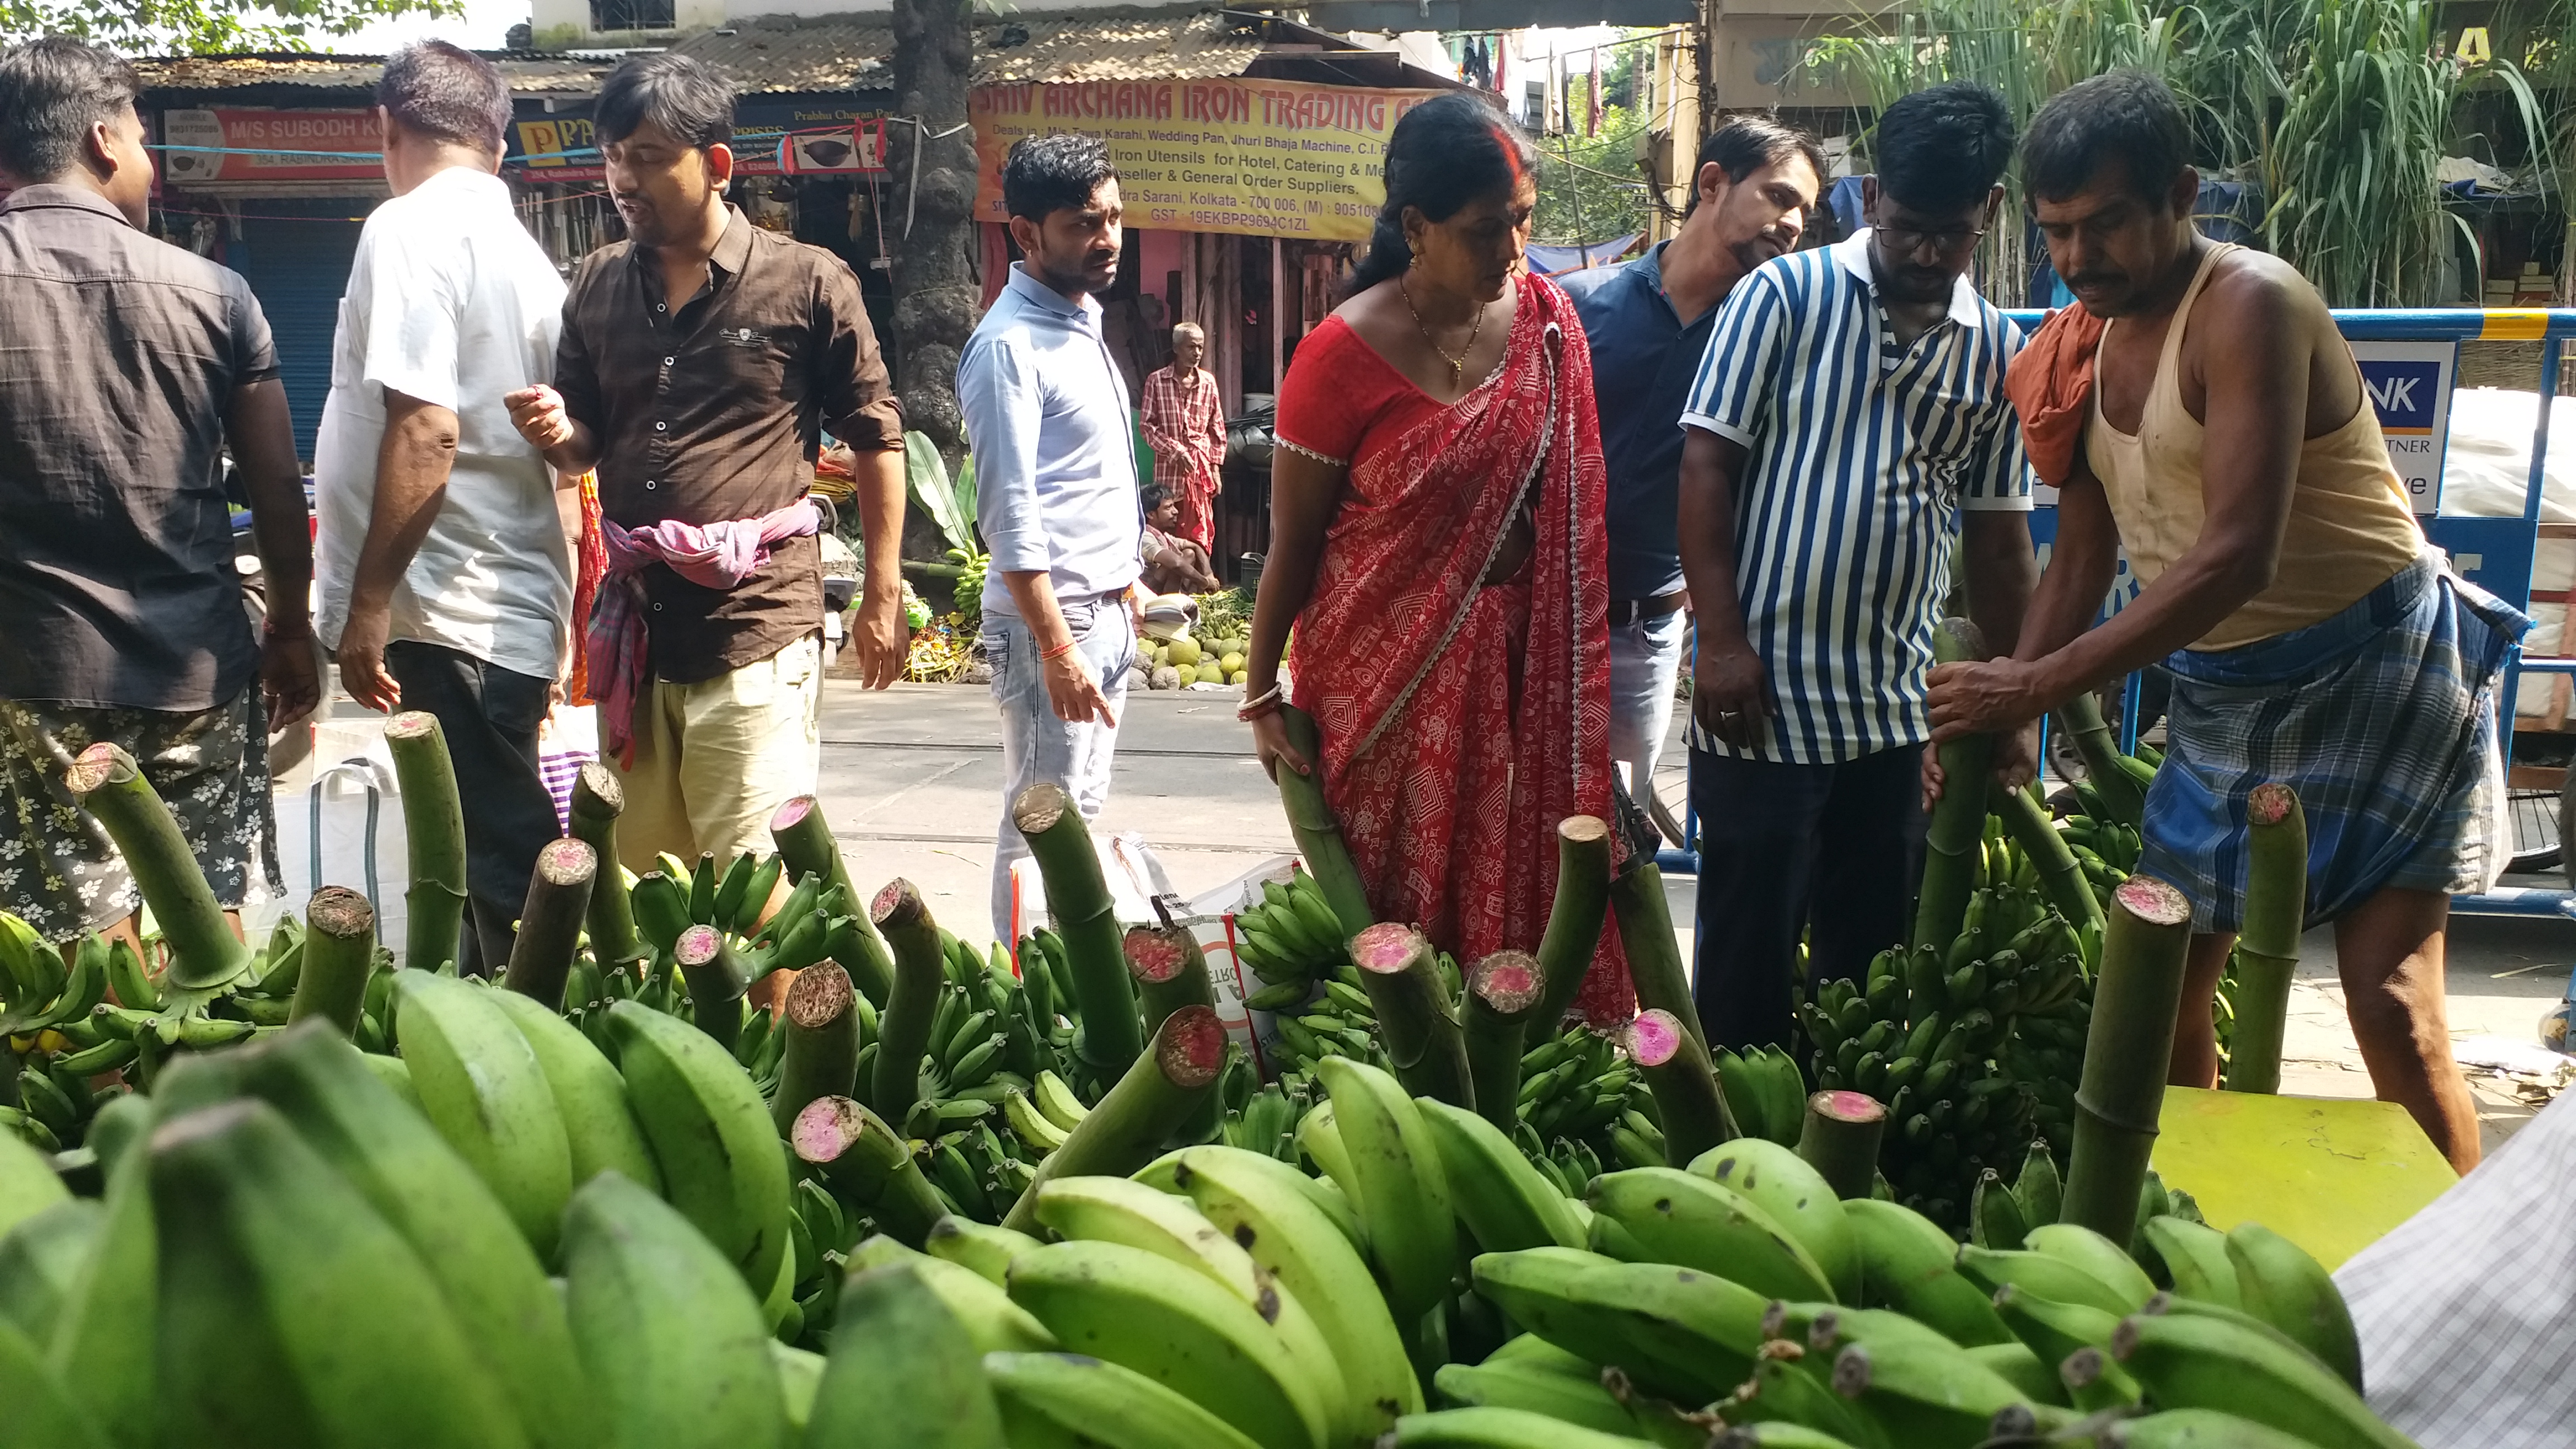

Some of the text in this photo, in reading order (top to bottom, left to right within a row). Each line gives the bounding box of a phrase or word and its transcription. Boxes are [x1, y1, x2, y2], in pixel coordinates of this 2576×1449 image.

[794, 110, 832, 121] Prabhu
[835, 108, 873, 120] Charan
[1043, 83, 1173, 121] ARCHANA
[1182, 85, 1251, 125] IRON
[1259, 90, 1385, 133] TRADING
[231, 120, 265, 138] M/S
[271, 119, 356, 138] SUBODH
[993, 125, 1024, 135] Deals
[1105, 129, 1146, 141] Karahi,
[1148, 130, 1199, 145] Wedding
[1202, 131, 1228, 145] Pan,
[1231, 134, 1261, 146] Jhuri
[1265, 136, 1298, 152] Bhaja
[1301, 139, 1355, 155] Machine,
[1115, 149, 1143, 162] Iron
[1147, 149, 1206, 164] Utensils
[1214, 152, 1234, 166] for
[1238, 154, 1281, 171] Hotel,
[1284, 158, 1345, 178] Catering
[1349, 164, 1360, 176] &
[1167, 170, 1177, 182] &
[1182, 170, 1238, 186] General
[1243, 174, 1283, 189] Order
[1287, 177, 1360, 195] Suppliers.
[1142, 189, 1186, 205] Sarani,
[1190, 192, 1237, 207] Kolkata
[1249, 196, 1270, 210] 700
[1274, 197, 1300, 214] 006,
[1303, 200, 1323, 216] (M)
[1151, 208, 1177, 221] GST
